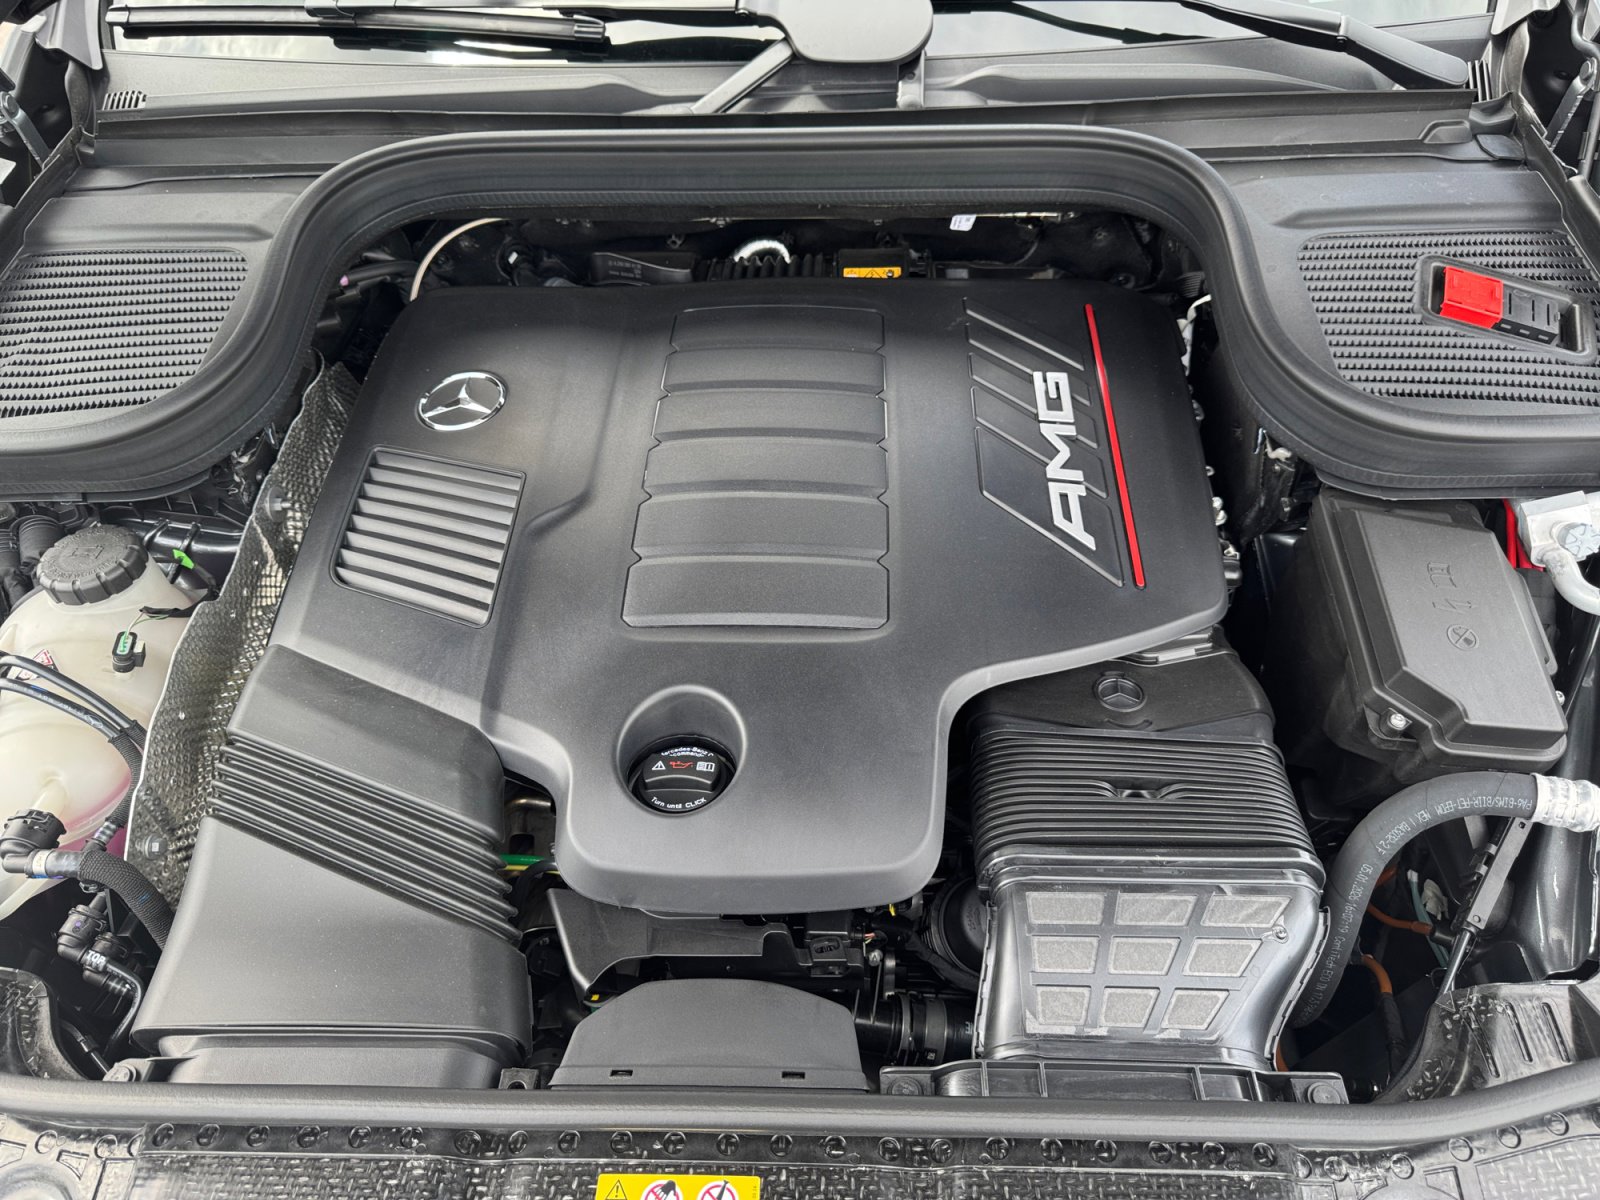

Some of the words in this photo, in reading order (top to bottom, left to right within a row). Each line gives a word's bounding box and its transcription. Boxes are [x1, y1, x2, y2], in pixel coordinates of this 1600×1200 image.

[1033, 371, 1096, 551] AMG
[651, 796, 665, 807] Turn
[685, 797, 707, 808] CLICK
[87, 949, 106, 964] TOP
